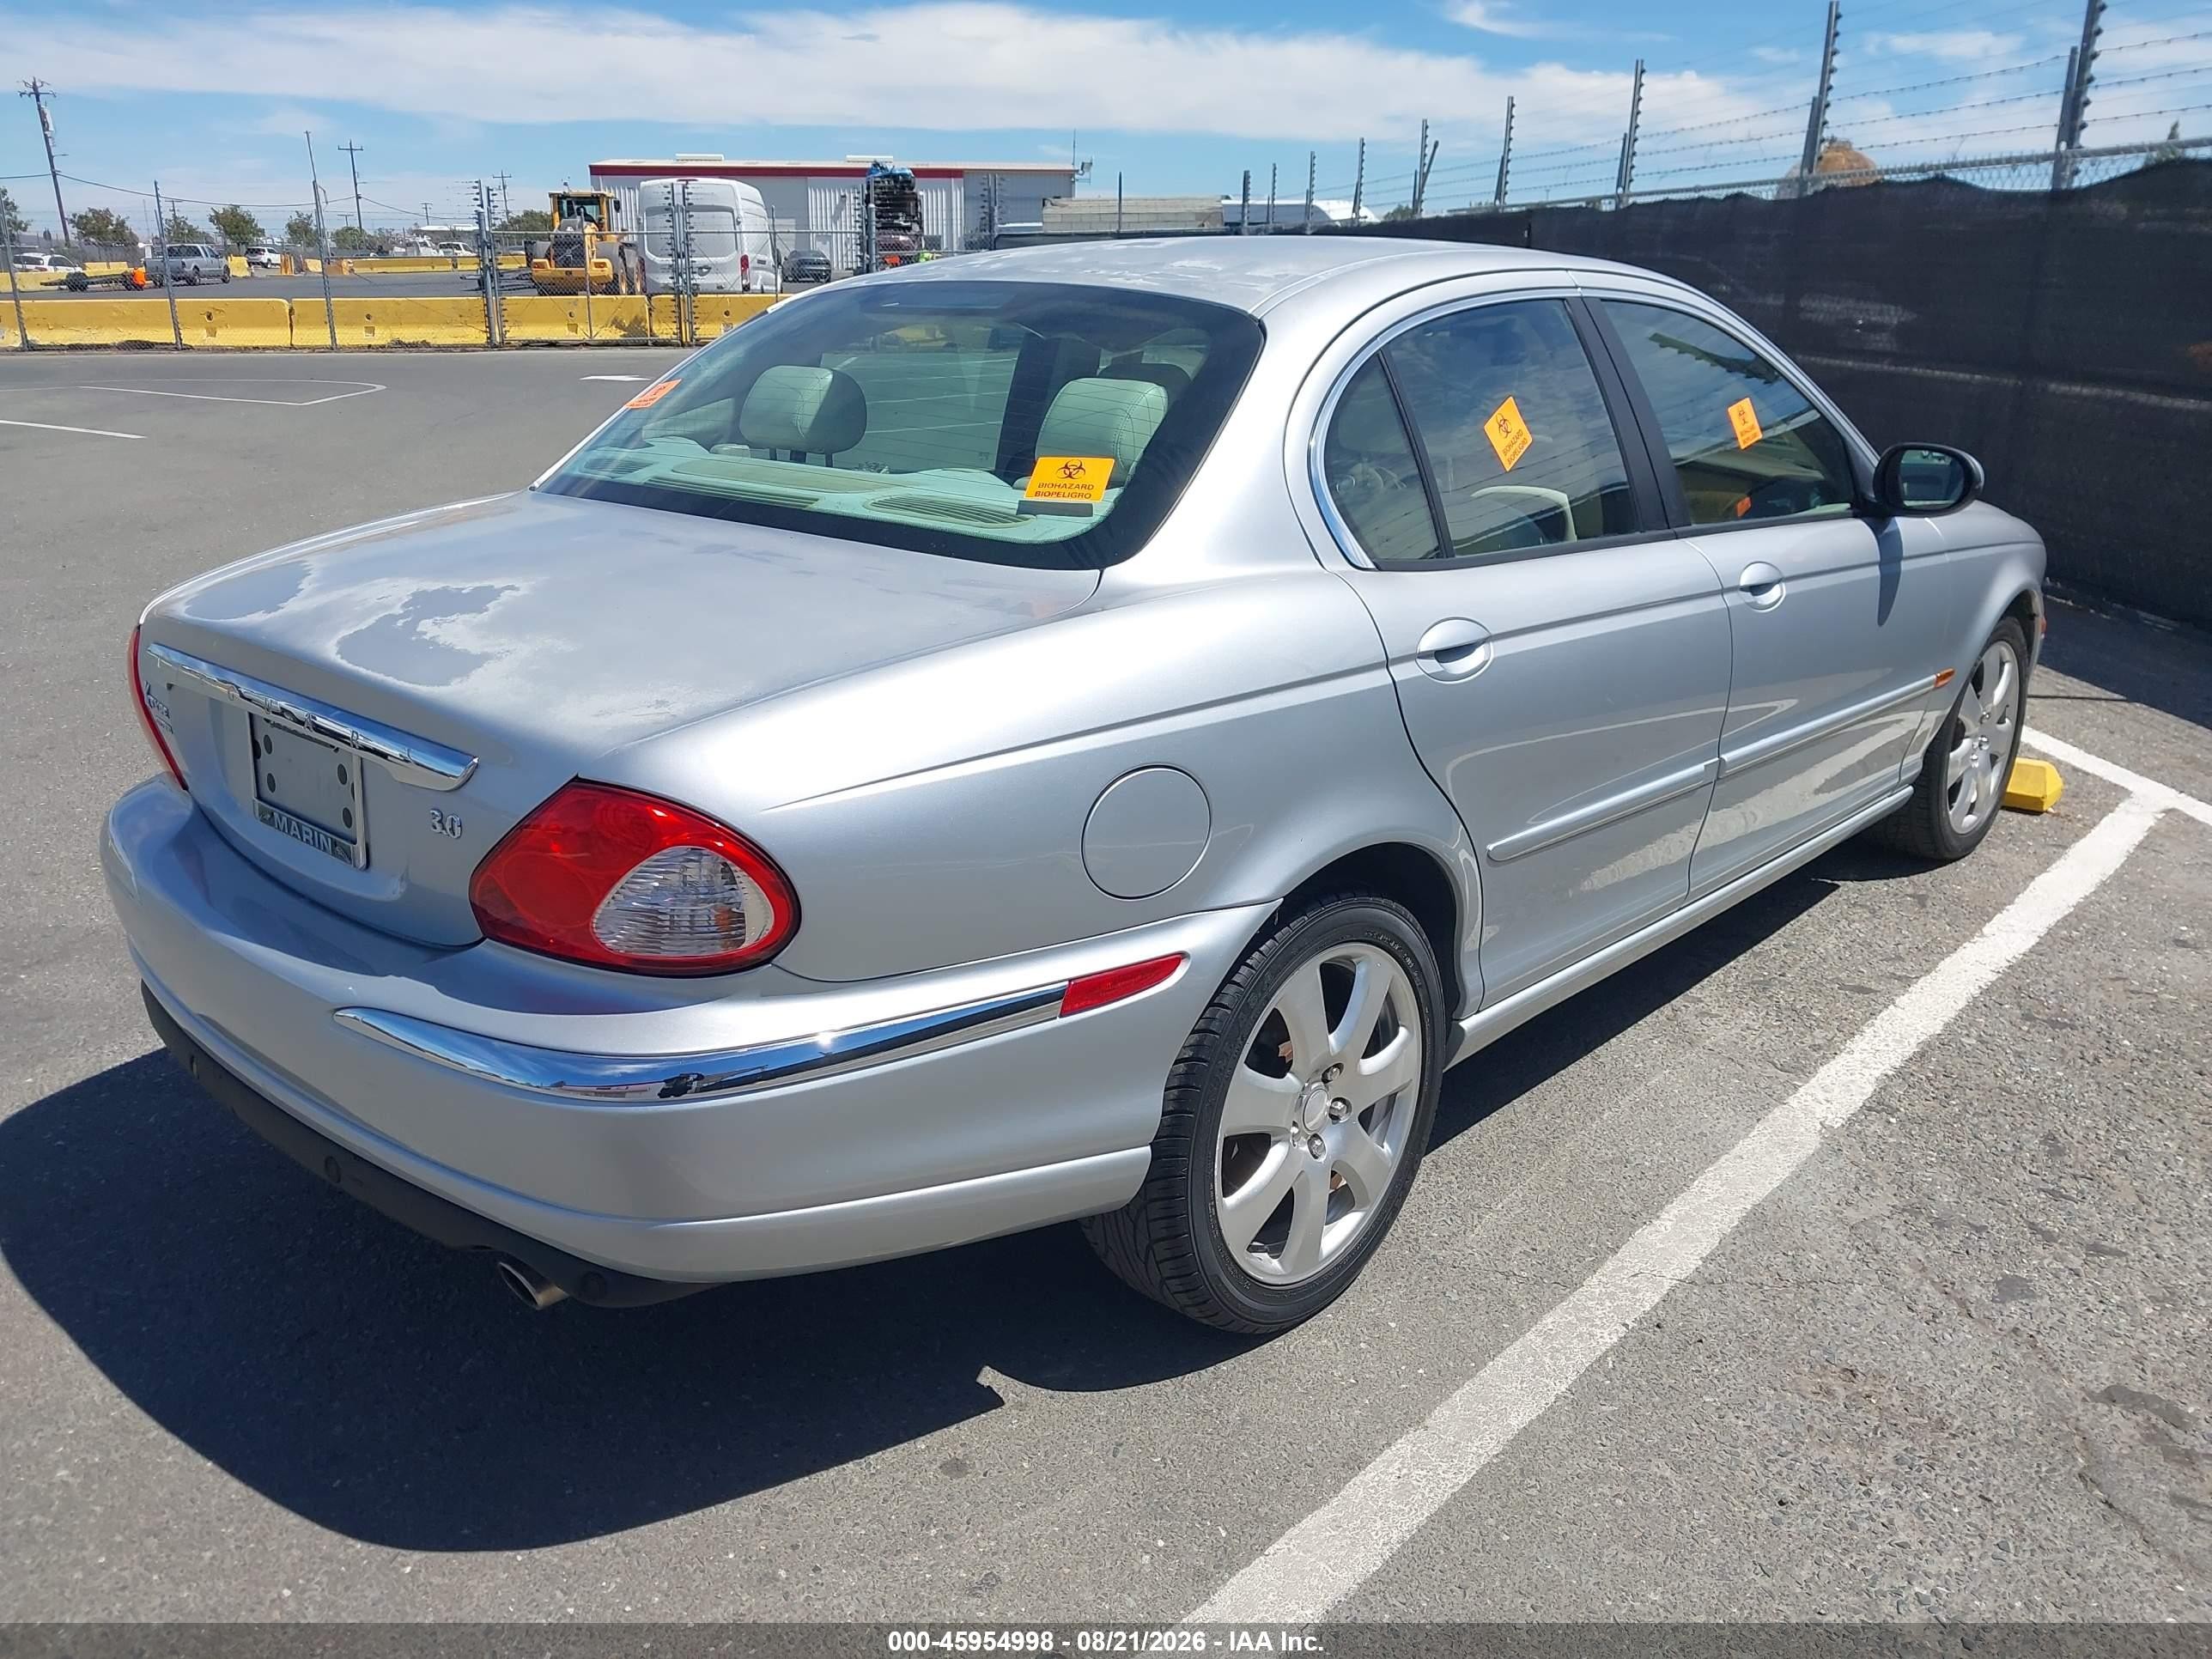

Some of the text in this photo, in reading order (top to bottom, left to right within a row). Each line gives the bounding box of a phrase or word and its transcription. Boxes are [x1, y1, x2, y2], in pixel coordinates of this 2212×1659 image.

[1034, 490, 1091, 499] BIOPELIGRO
[1037, 482, 1094, 490] BIOHAZARD
[273, 811, 332, 855] MARIN
[429, 809, 462, 839] 3.0
